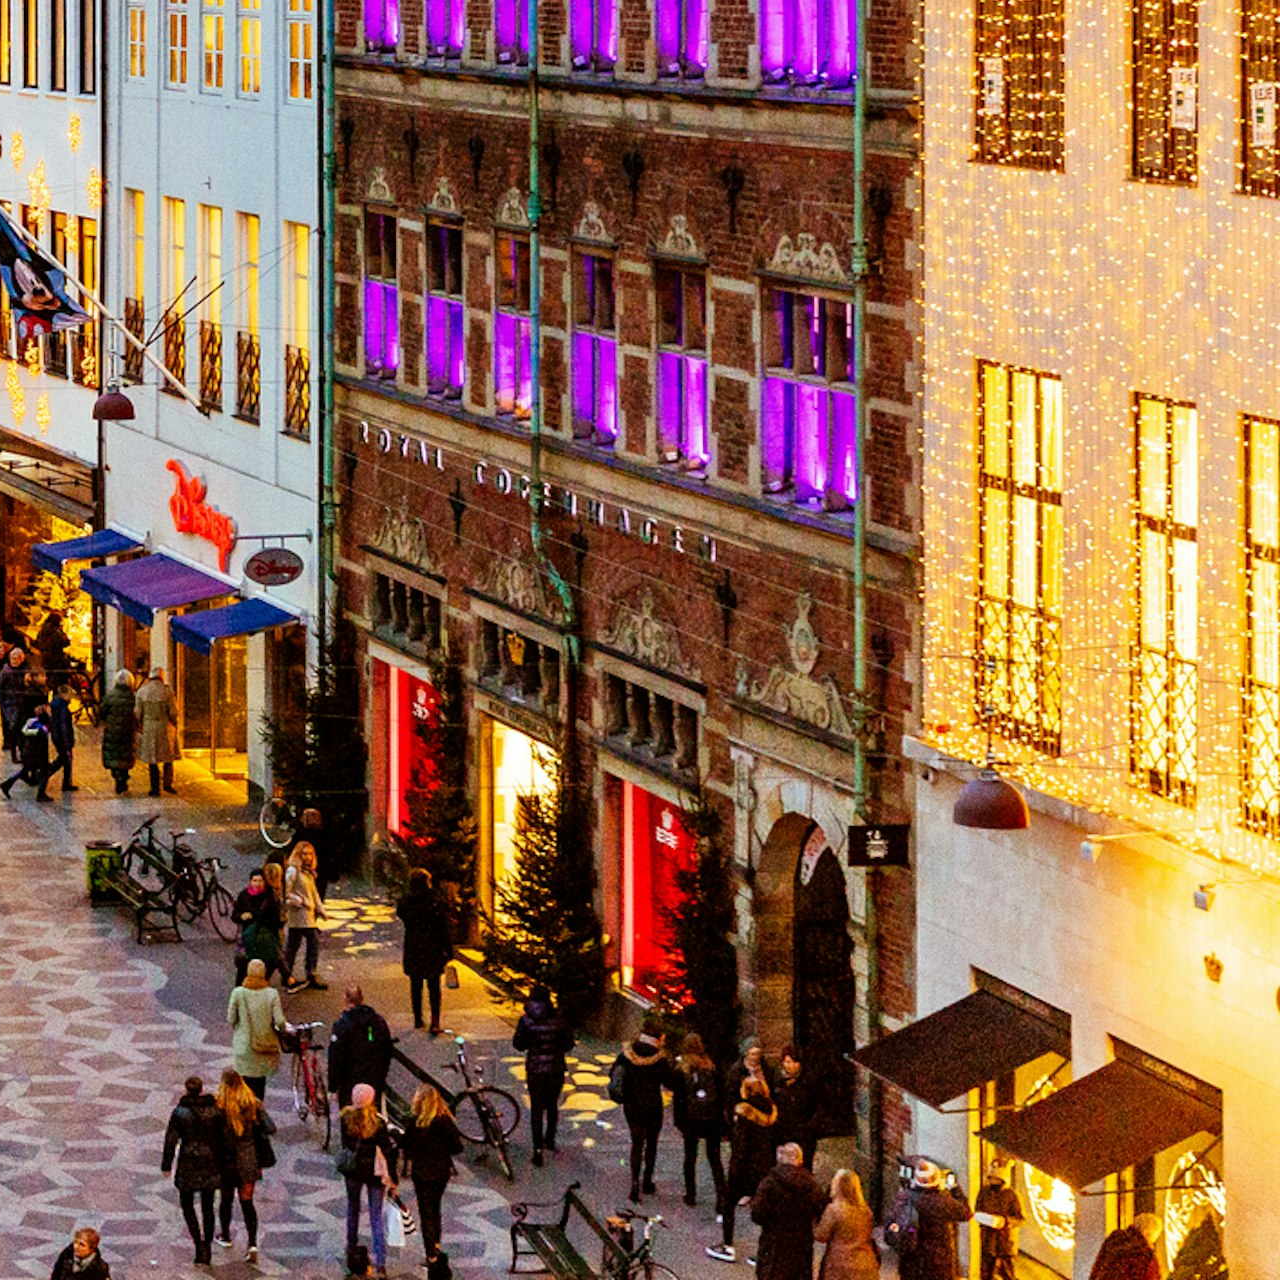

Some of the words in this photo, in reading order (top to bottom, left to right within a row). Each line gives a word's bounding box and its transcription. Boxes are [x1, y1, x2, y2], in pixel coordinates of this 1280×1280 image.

[358, 420, 445, 471] ROYAL
[472, 461, 718, 564] COPENHAGEN
[248, 559, 300, 579] Disney
